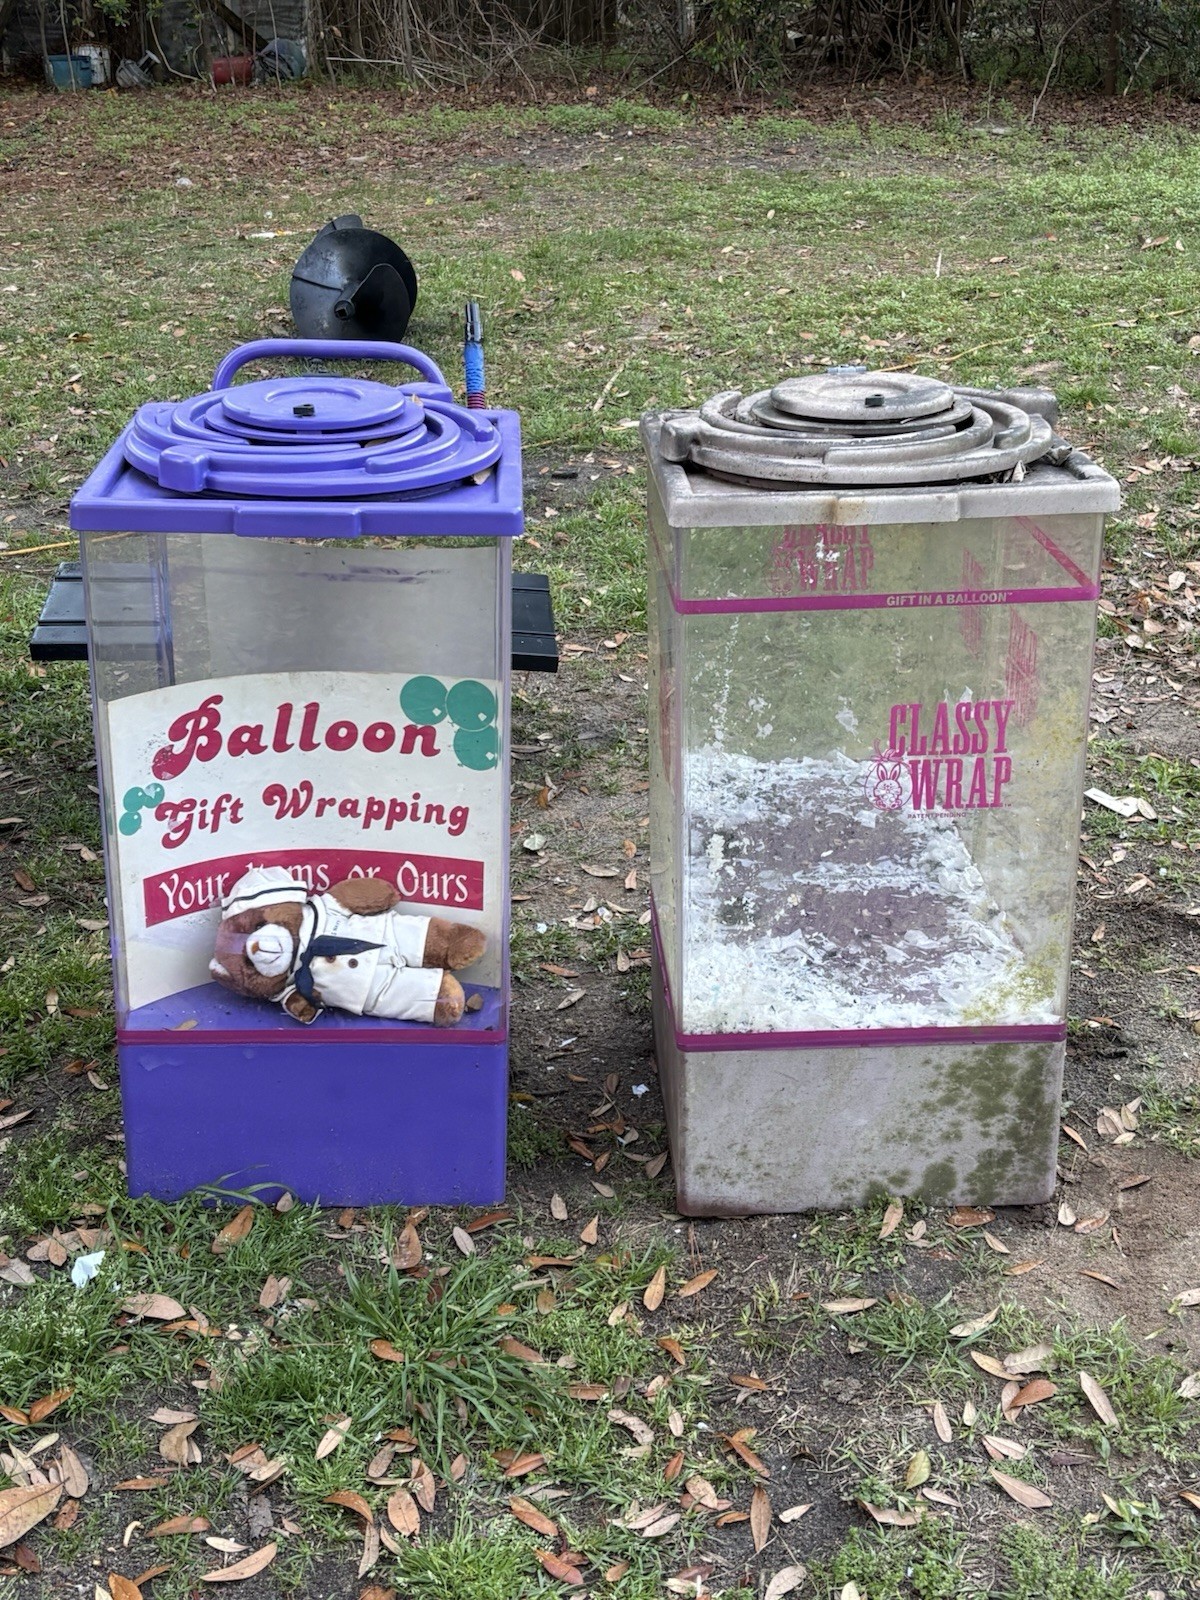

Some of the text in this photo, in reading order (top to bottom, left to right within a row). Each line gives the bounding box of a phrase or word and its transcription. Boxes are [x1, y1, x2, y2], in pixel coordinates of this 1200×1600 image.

[886, 594, 916, 607] GIFT
[918, 595, 931, 606] IN
[934, 594, 944, 605] A
[151, 694, 441, 781] Balloon
[889, 700, 1015, 758] CLASSY
[154, 780, 470, 850] Gift Wrapping
[159, 872, 230, 914] Your
[396, 860, 469, 903] Ours
